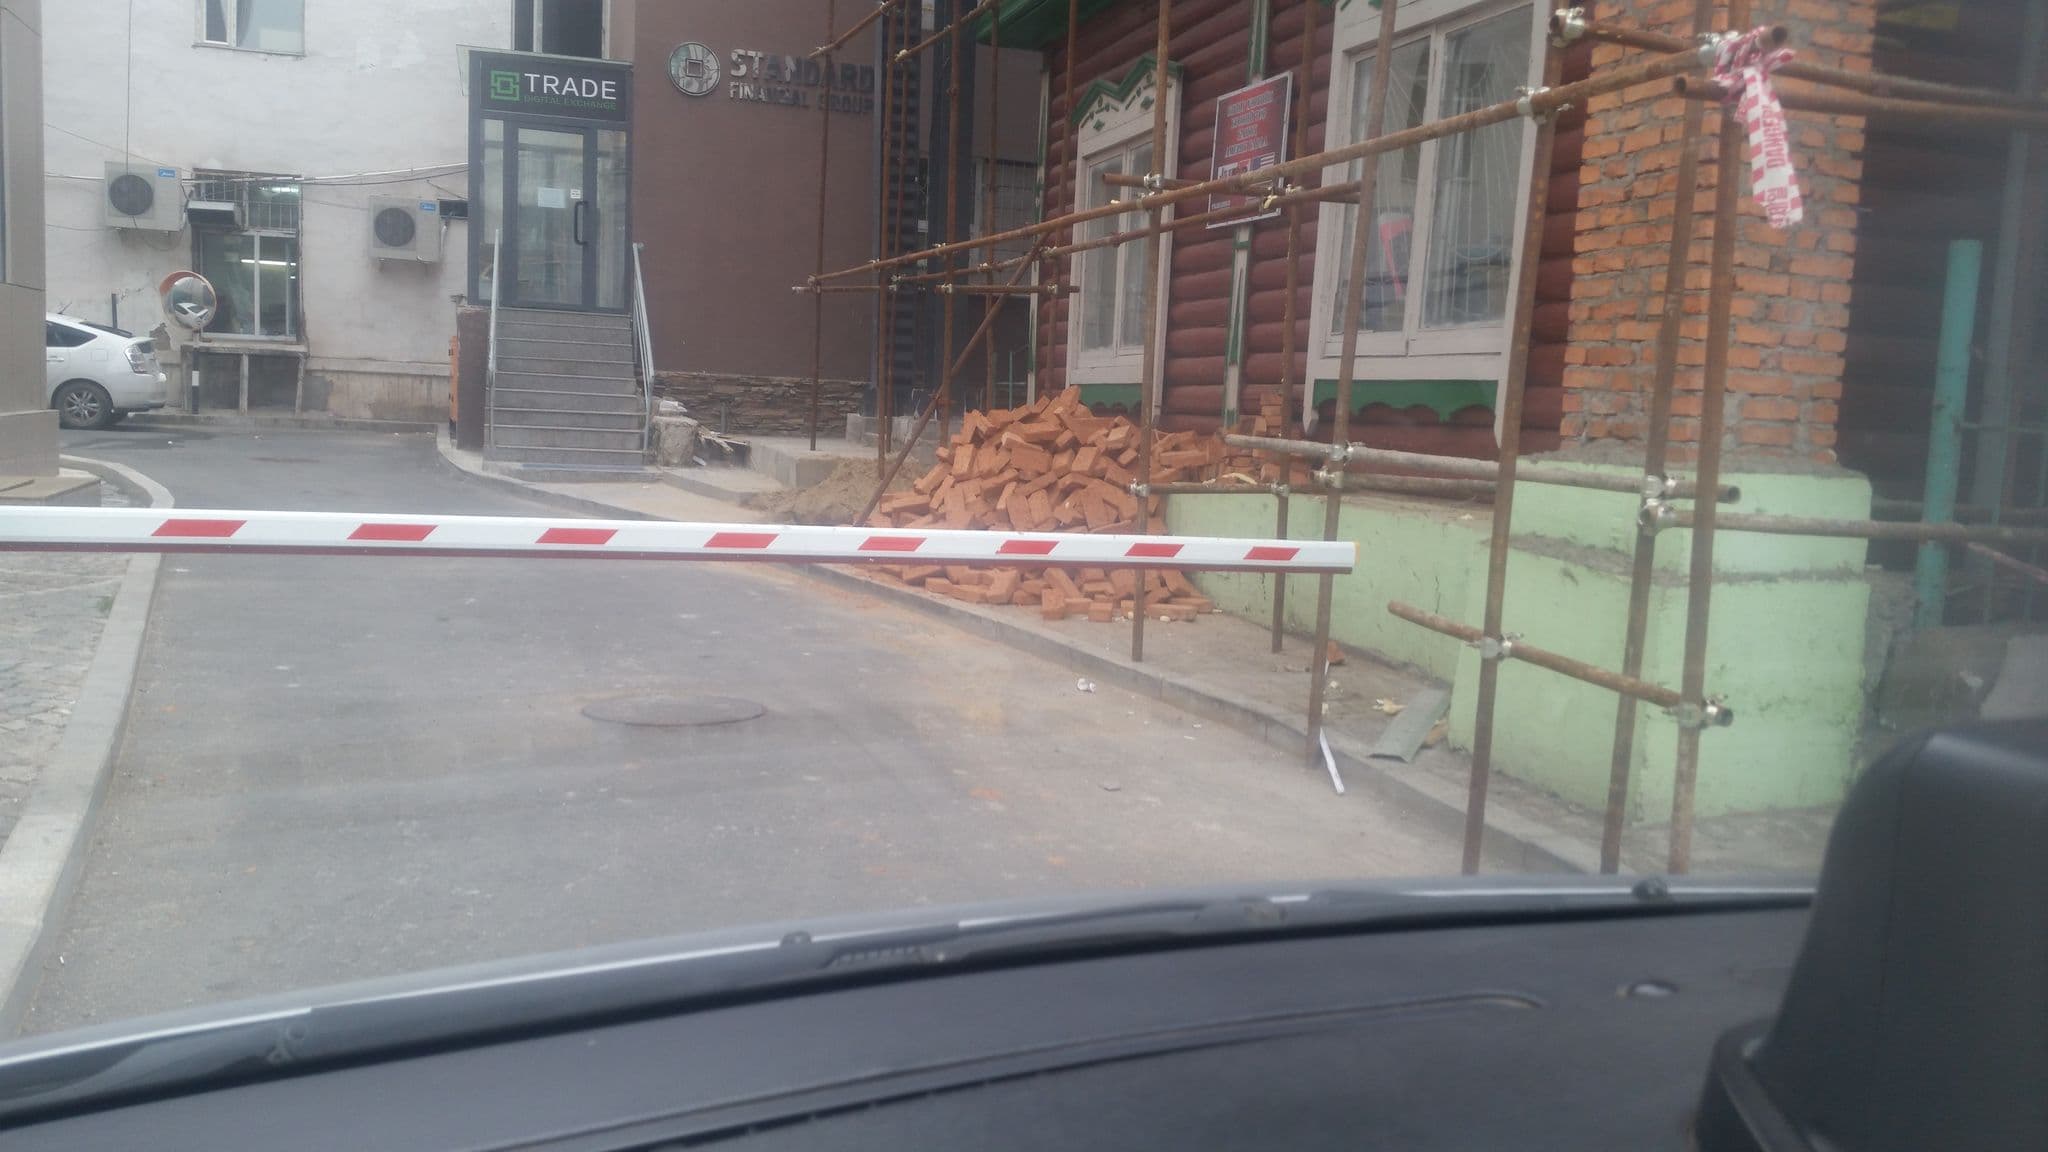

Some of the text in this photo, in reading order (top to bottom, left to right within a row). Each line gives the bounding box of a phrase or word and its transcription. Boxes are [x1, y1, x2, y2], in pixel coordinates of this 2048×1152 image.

[730, 48, 875, 92] STANDARD
[524, 73, 617, 100] TRADE
[729, 81, 809, 107] FINANCIAL
[523, 95, 617, 111] DIGITAL EXCHANGE
